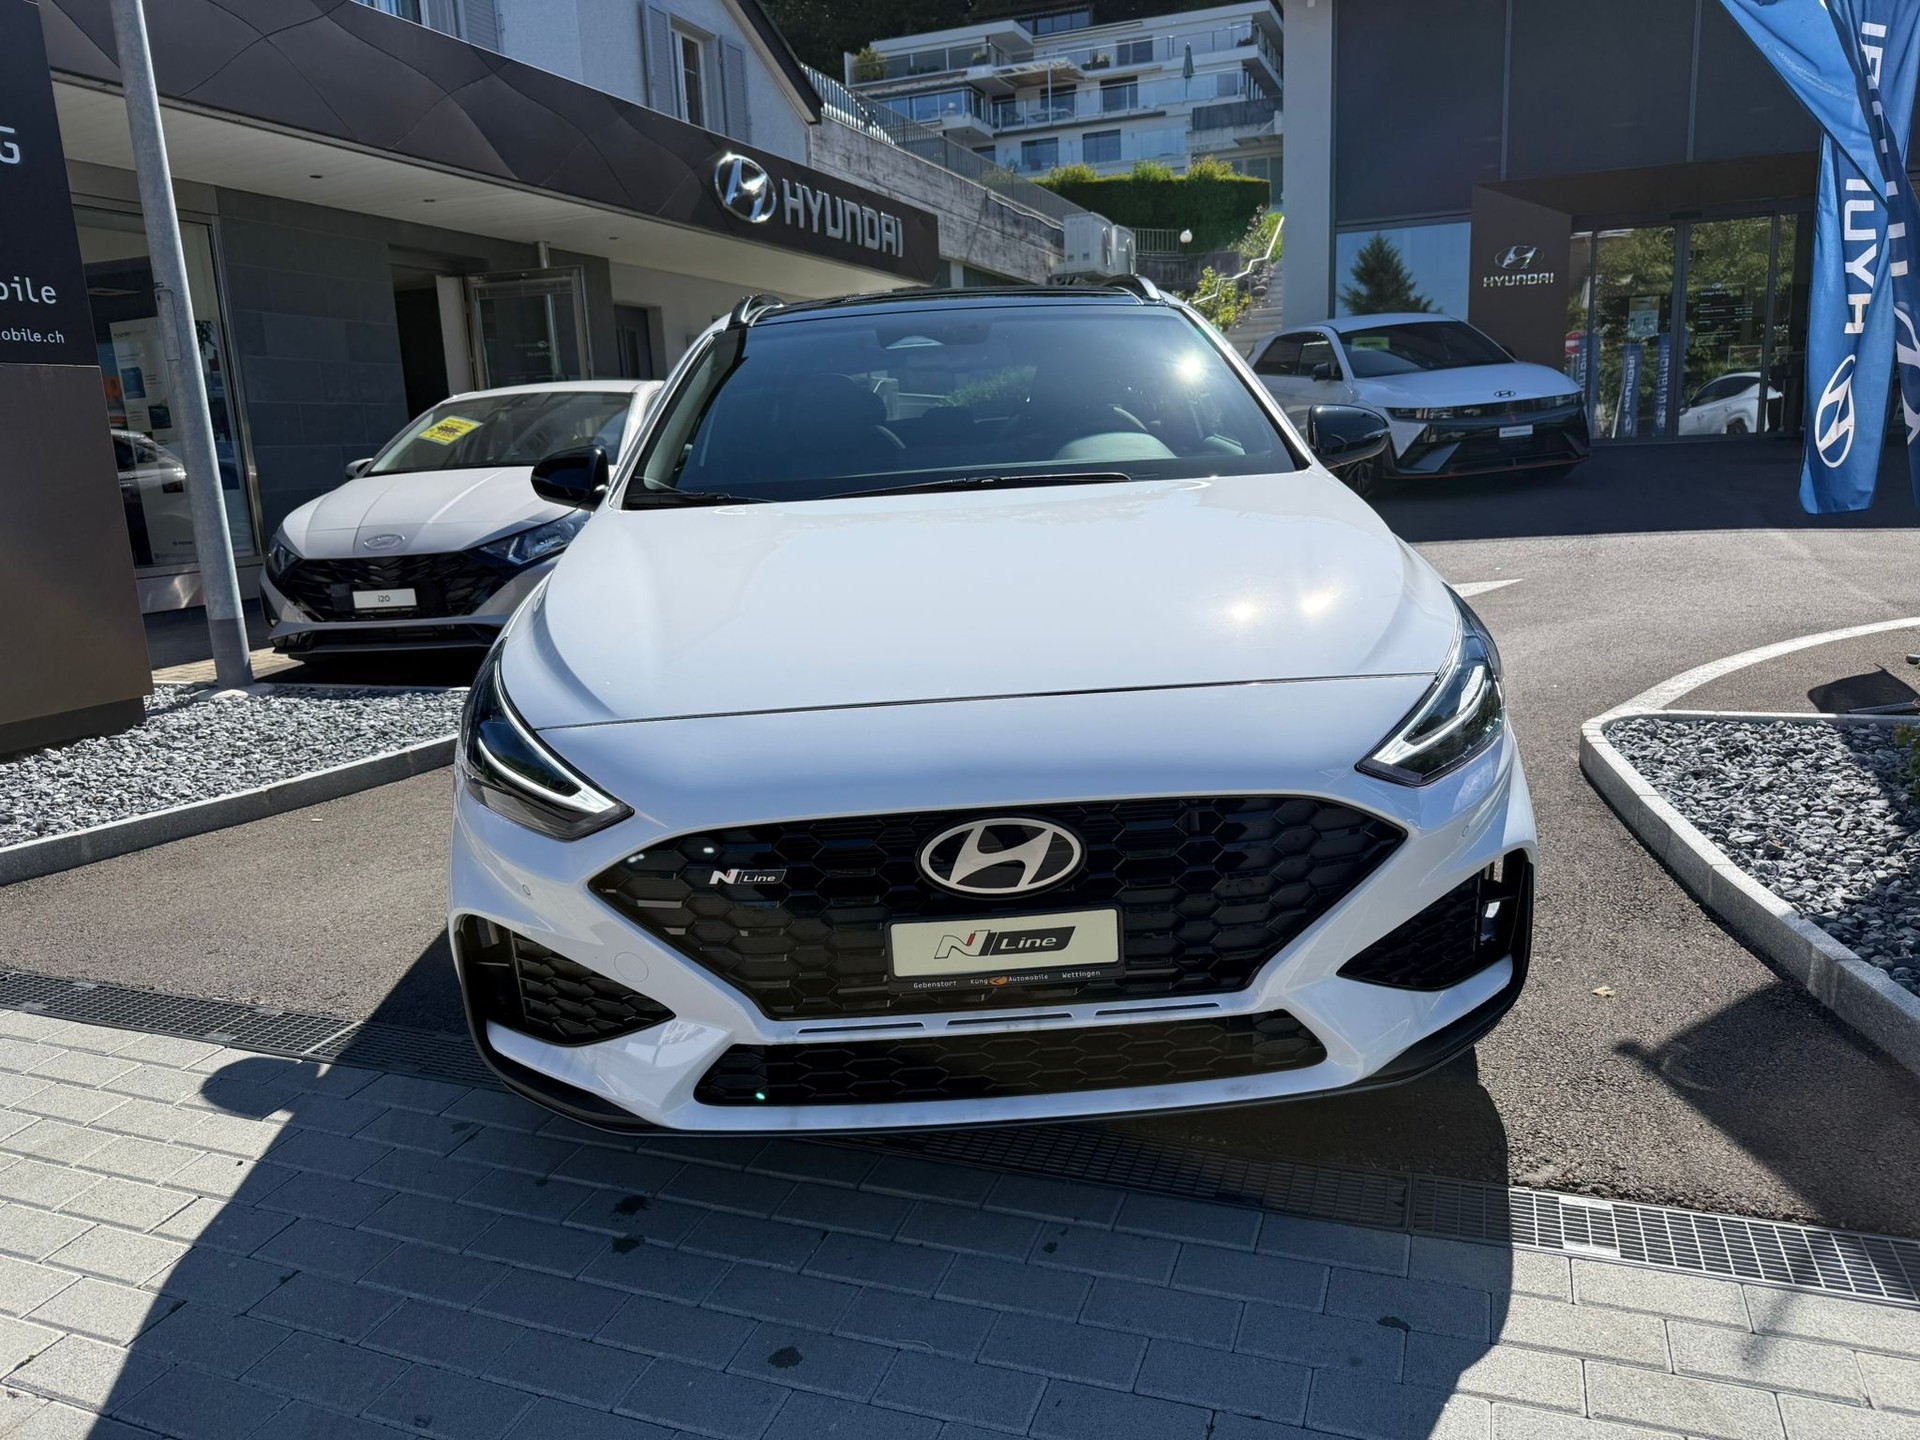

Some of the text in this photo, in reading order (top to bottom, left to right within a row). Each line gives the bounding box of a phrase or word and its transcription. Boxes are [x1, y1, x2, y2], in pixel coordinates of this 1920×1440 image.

[782, 177, 903, 257] HYUNDAI
[1483, 272, 1554, 287] HYUNDAI
[743, 874, 776, 882] Line
[1000, 936, 1057, 950] Line
[1008, 973, 1049, 982] Automobile
